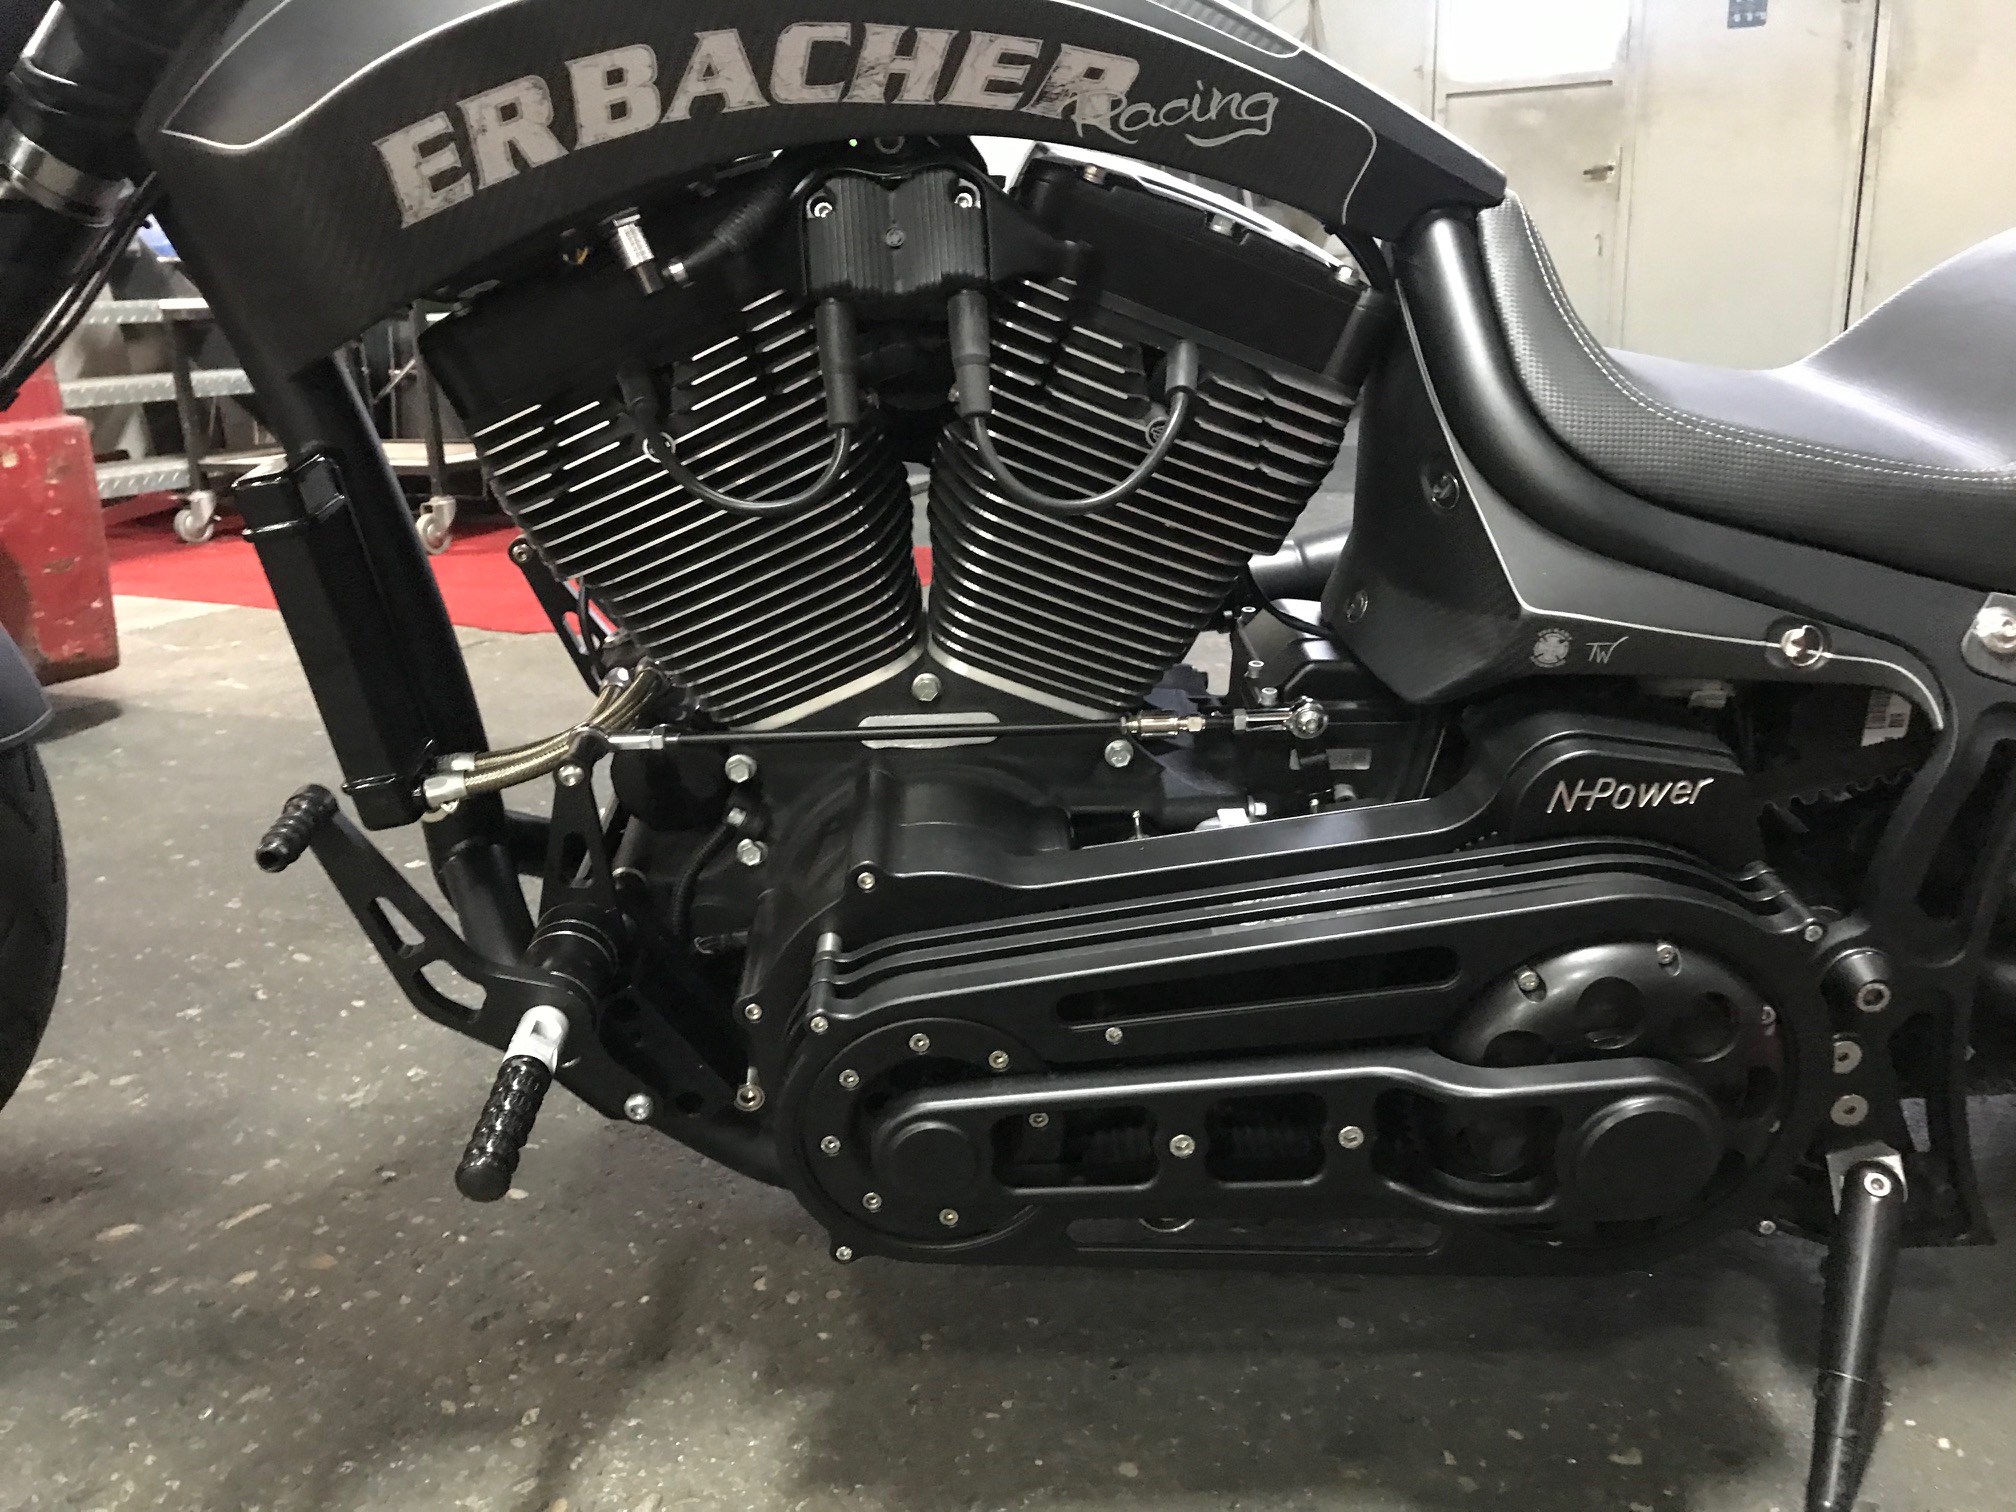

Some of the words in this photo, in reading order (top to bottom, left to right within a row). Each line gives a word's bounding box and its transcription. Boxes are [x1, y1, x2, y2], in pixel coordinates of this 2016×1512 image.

[373, 22, 1139, 228] ERBACHER
[1060, 80, 1279, 147] Racing
[1546, 777, 1714, 814] N-Power
